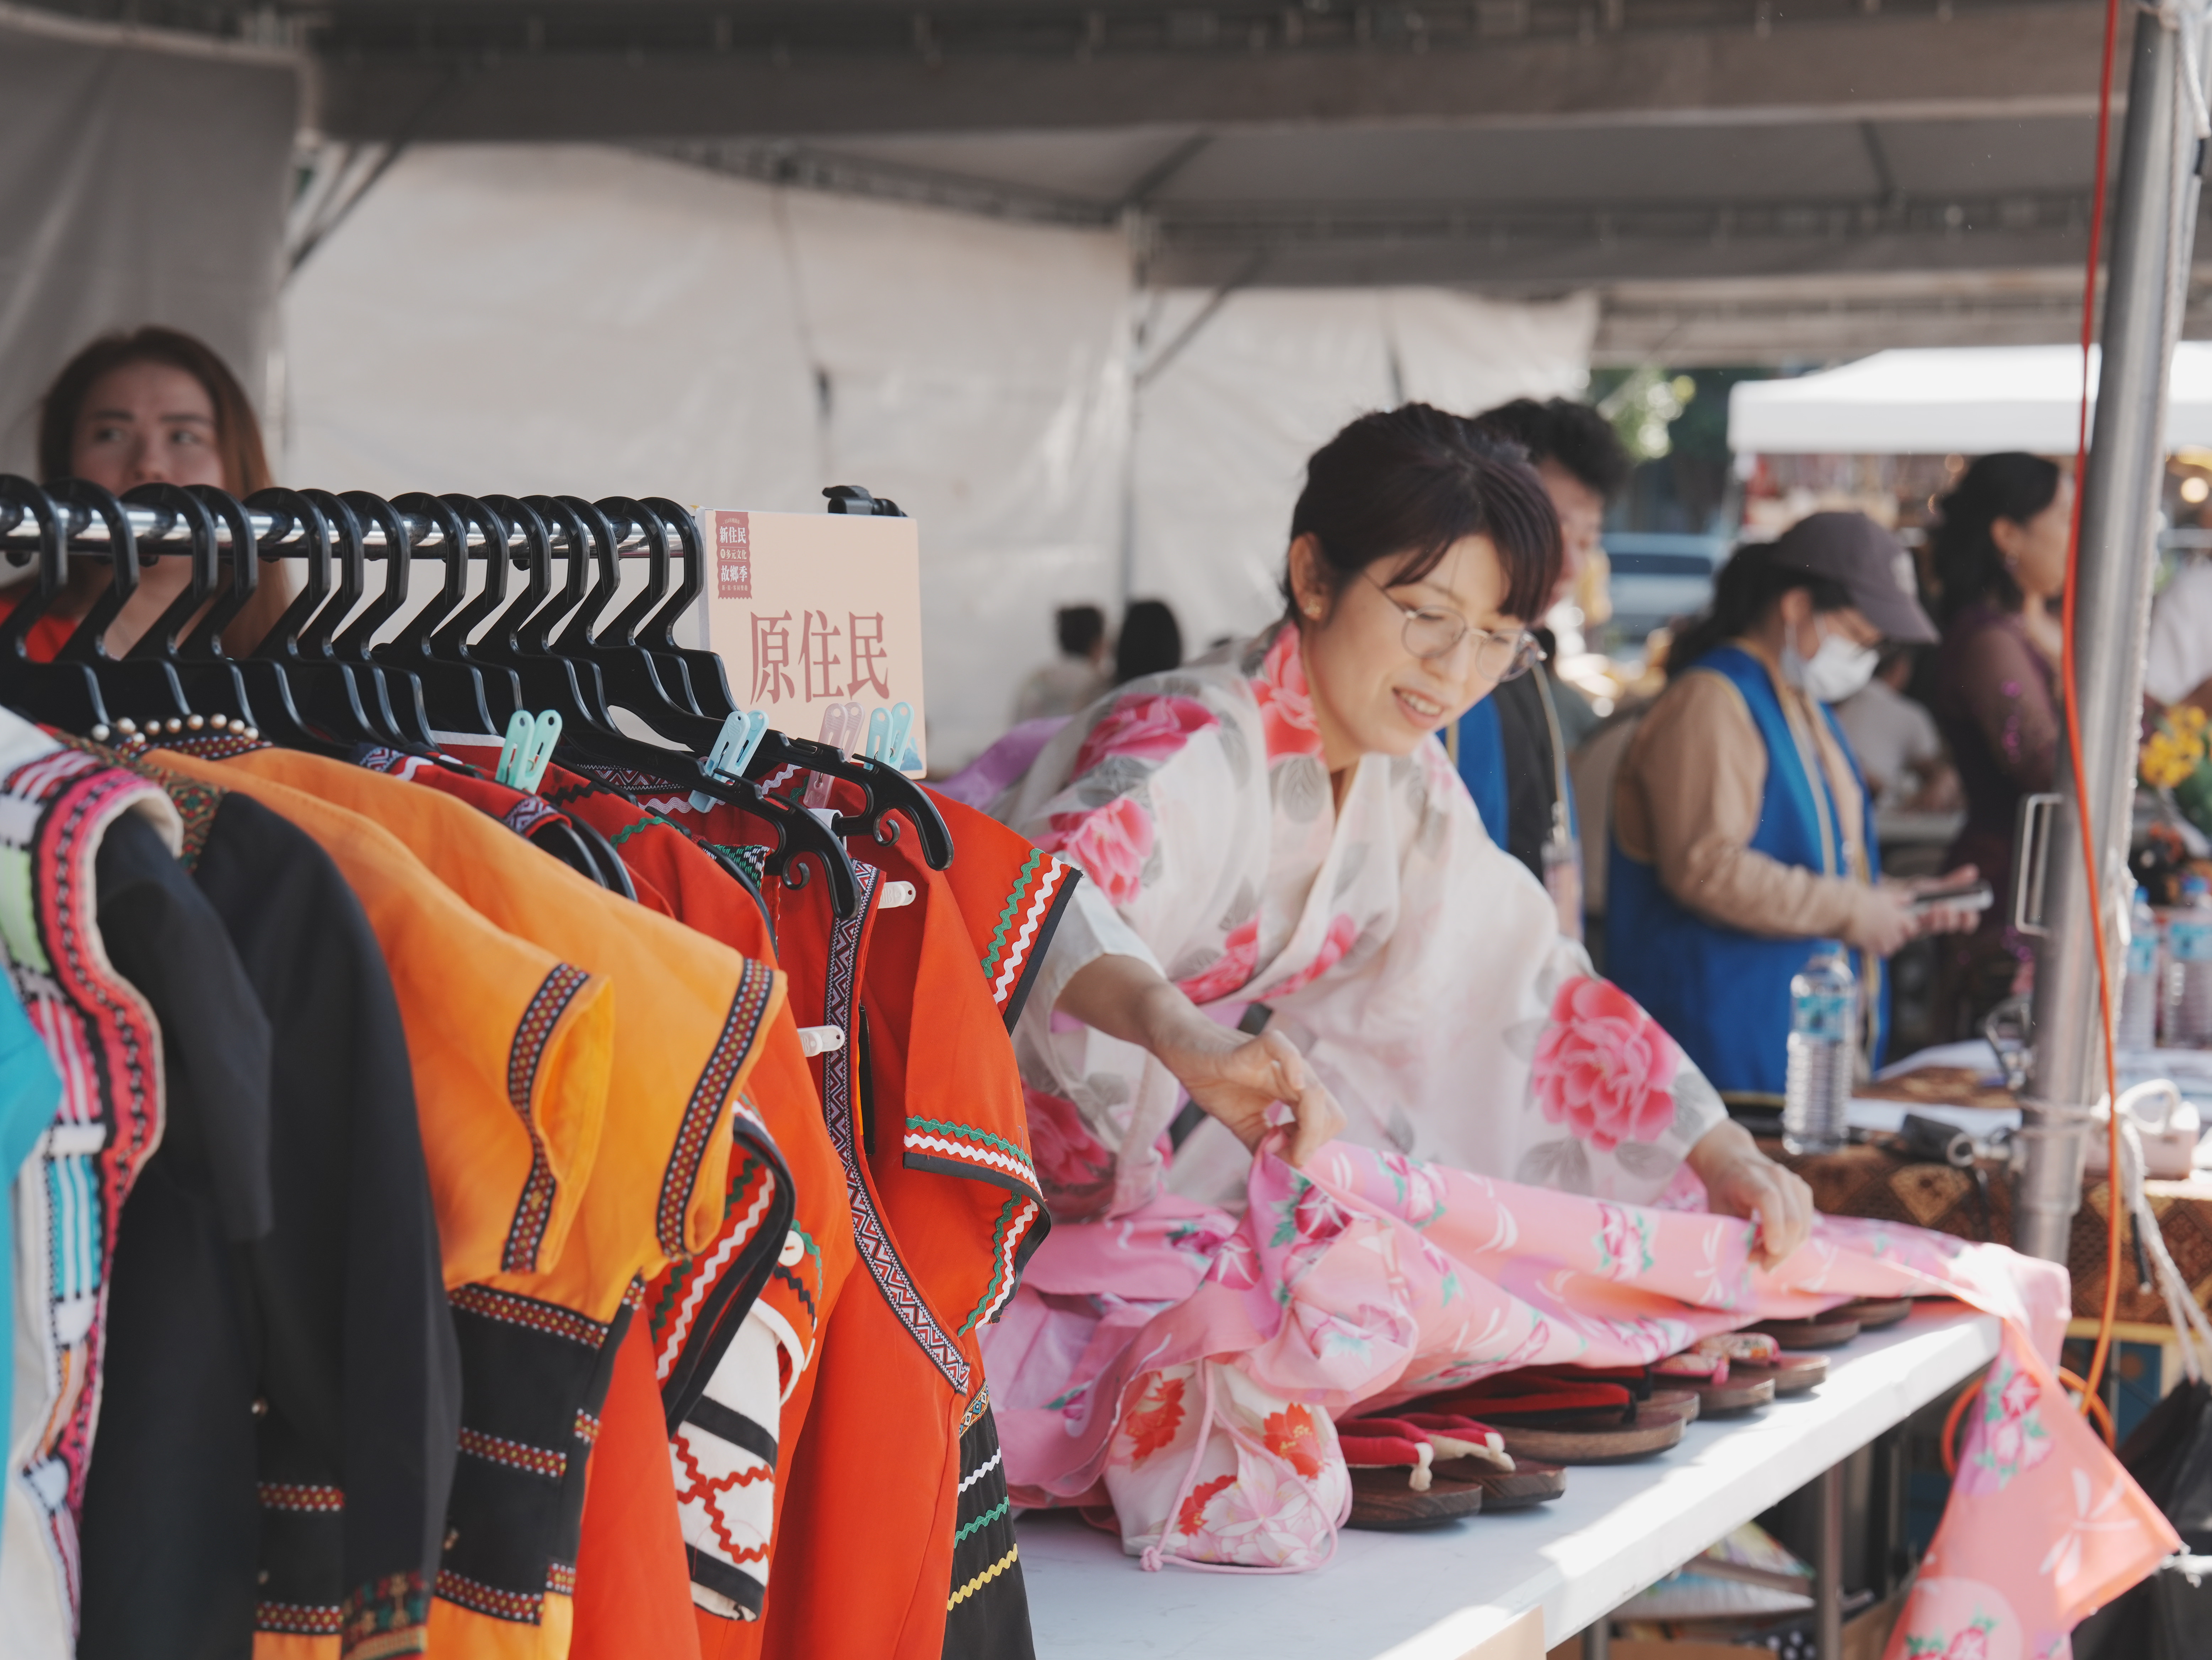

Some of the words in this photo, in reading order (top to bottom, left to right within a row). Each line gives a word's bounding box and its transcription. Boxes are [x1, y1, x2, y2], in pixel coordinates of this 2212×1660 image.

[719, 526, 746, 543] 新住民
[721, 565, 747, 582] 故鄉季
[750, 610, 890, 705] 原住民
